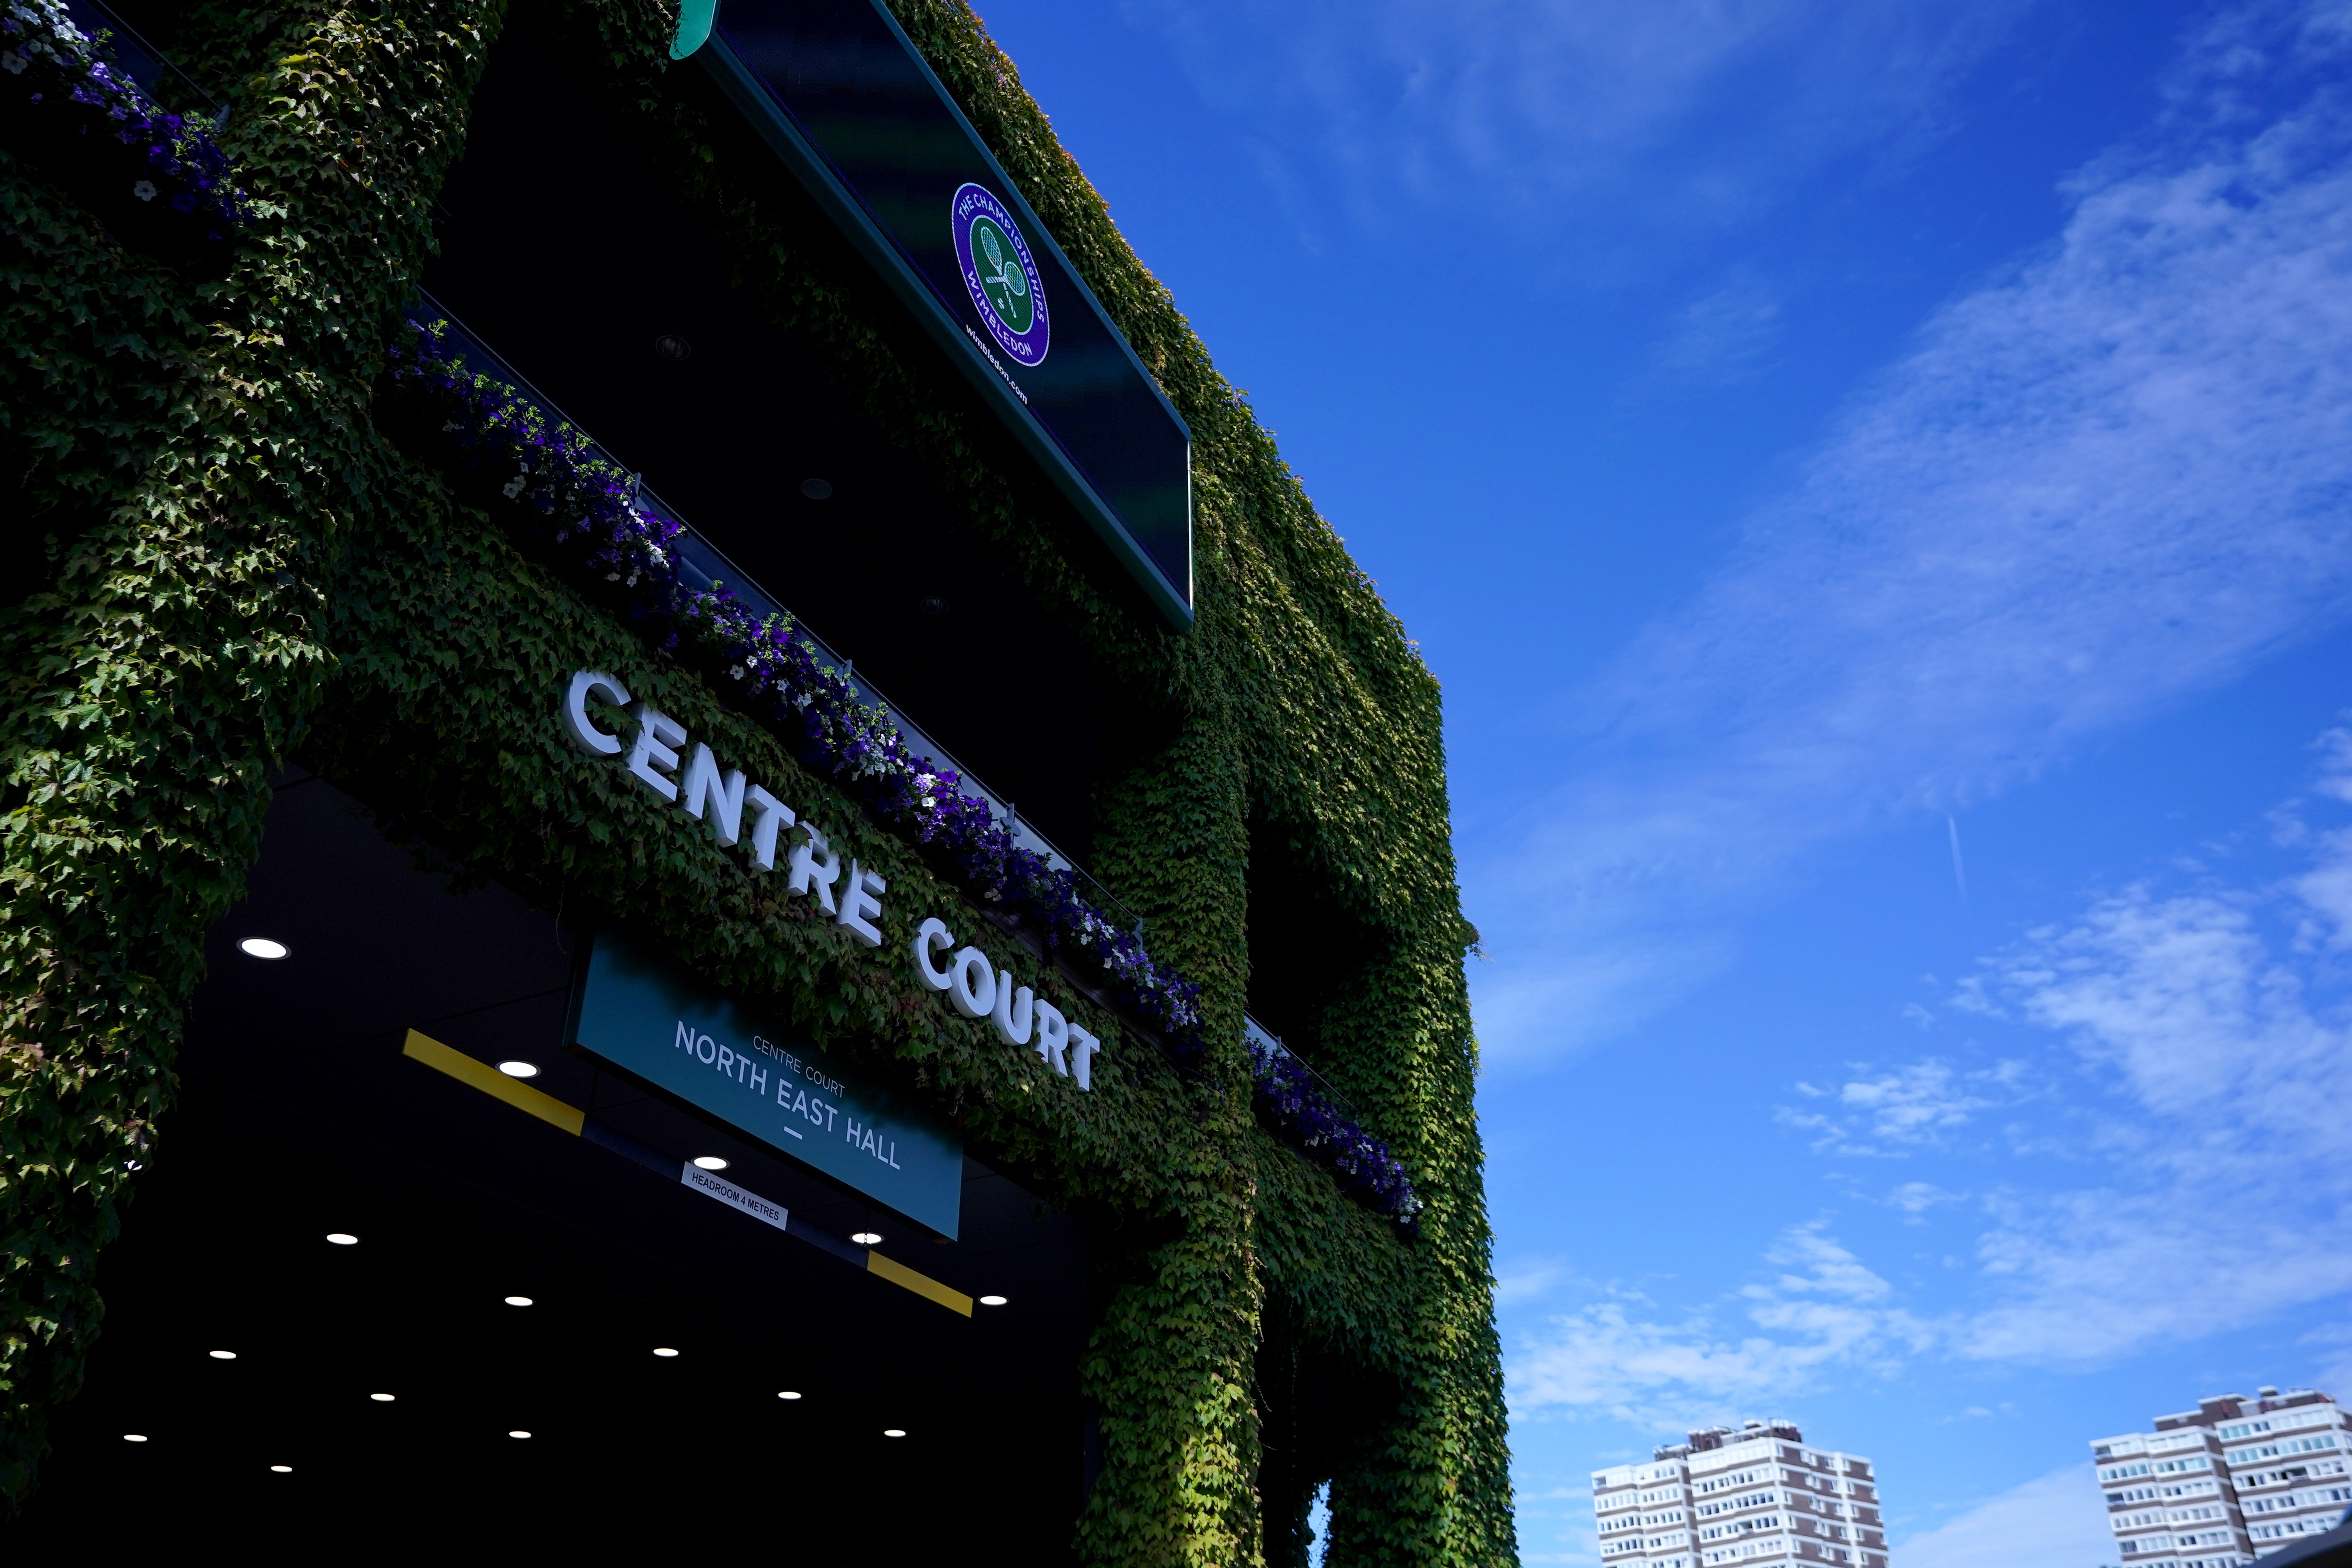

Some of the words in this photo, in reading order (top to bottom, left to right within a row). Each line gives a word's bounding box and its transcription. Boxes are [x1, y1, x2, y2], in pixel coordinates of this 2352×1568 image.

[959, 195, 974, 220] THE
[973, 194, 1045, 323] CHAMPIONSHIPS
[968, 271, 1033, 356] WIMBLEDON
[966, 324, 1027, 405] wimbledon.com
[562, 671, 886, 947] CENTRE
[911, 917, 1100, 1091] COURT
[675, 1021, 767, 1095] NORTH
[777, 1078, 838, 1132] EAST
[846, 1117, 900, 1170] HALL
[753, 1035, 801, 1073] CENTRE
[806, 1066, 845, 1097] COURT
[692, 1172, 739, 1202] HEADROOM
[741, 1196, 746, 1205] 4
[748, 1199, 779, 1220] METRES
